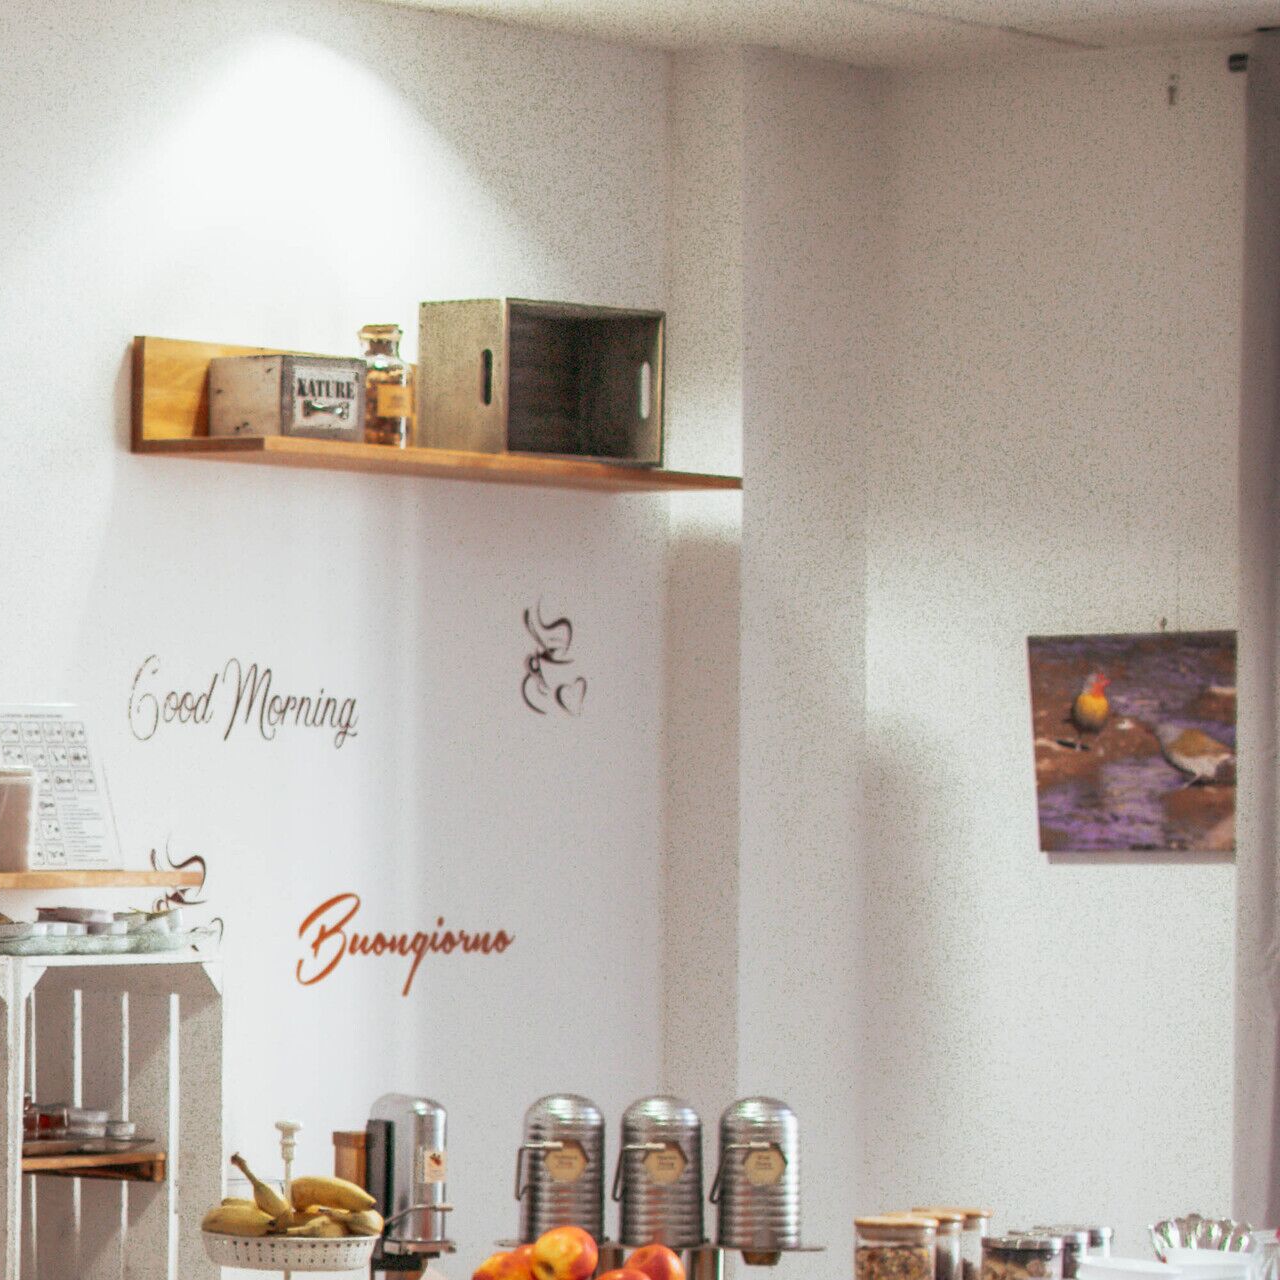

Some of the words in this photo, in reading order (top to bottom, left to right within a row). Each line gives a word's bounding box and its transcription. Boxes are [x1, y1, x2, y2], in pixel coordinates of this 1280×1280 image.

[297, 378, 355, 400] NATURE
[128, 654, 219, 741] Good
[222, 657, 359, 749] Morning
[296, 892, 516, 998] Buongiorno
